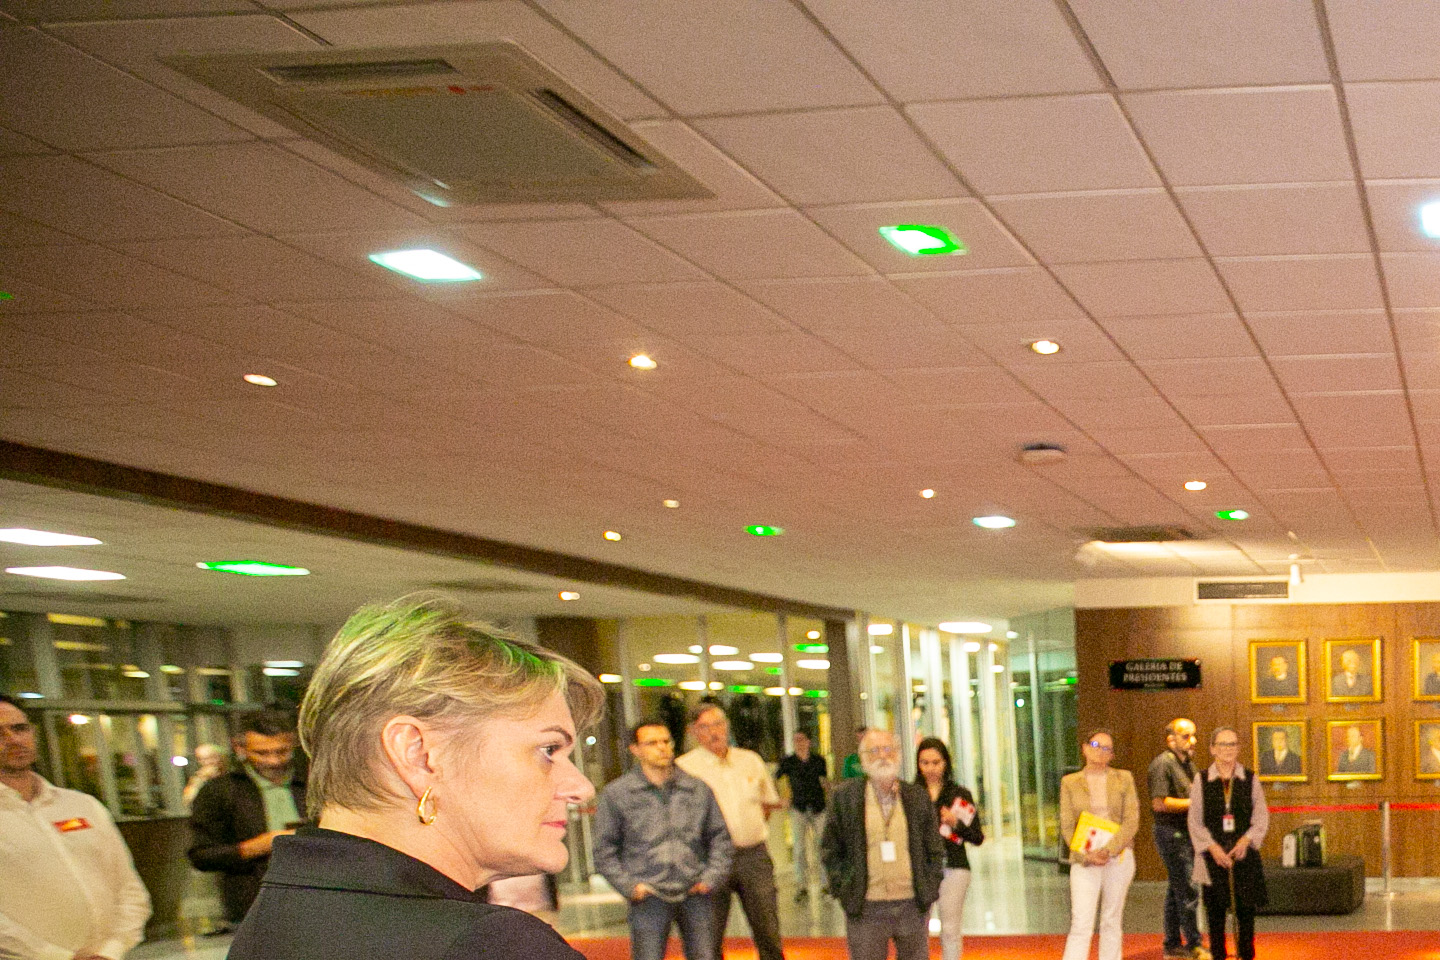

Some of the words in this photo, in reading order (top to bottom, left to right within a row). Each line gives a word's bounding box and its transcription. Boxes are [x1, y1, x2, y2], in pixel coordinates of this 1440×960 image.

[1125, 661, 1167, 671] GALERIA
[1169, 661, 1183, 671] DE
[1123, 672, 1188, 683] PRESIDENTES
